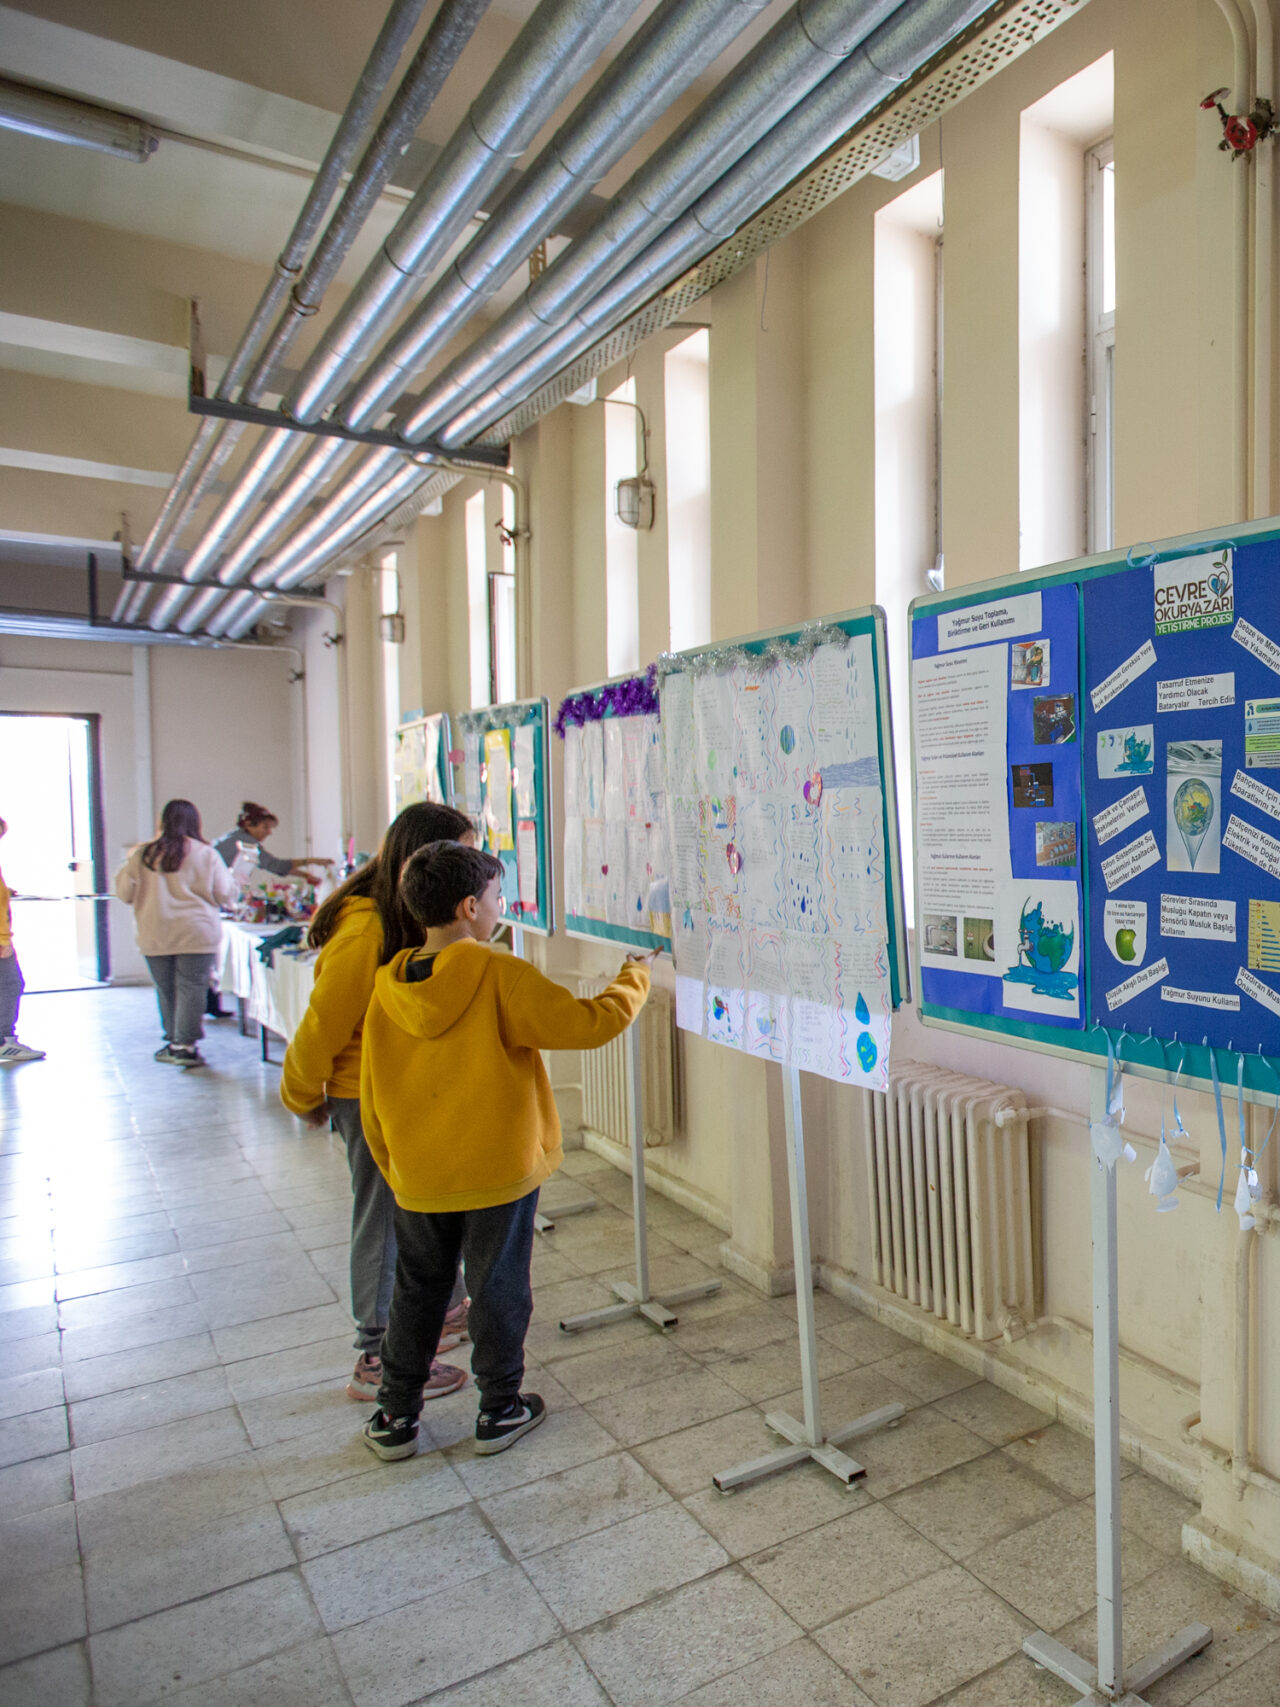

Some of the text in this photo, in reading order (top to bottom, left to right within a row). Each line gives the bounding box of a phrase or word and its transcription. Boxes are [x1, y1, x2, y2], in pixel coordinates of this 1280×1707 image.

[1155, 596, 1233, 622] OKURYAZARI
[1237, 620, 1256, 639] Sebze
[1257, 635, 1265, 645] ve
[1233, 630, 1280, 670] Suda Yıkamayın
[1158, 676, 1215, 689] Tasarruf Etmenize
[1158, 687, 1208, 700] Yardımcı Olacak
[1159, 695, 1235, 711] Bataryalar Tercih Edin
[1232, 782, 1268, 810] Aparatlarını
[1236, 771, 1265, 796] Bahçeniz
[1265, 788, 1278, 803] İçin
[1230, 816, 1260, 840] Bütçenizi
[1103, 834, 1153, 871] Sifon Sisteminde Su
[1224, 836, 1258, 863] Tüketimine
[1258, 860, 1267, 869] de
[1227, 827, 1251, 847] Elektrik
[1251, 842, 1260, 852] ve
[1260, 847, 1280, 864] Doğal
[1130, 864, 1142, 875] Alın
[1161, 905, 1229, 921] Musluğu Kapatın veya
[1189, 898, 1218, 908] Sırasında
[1161, 915, 1187, 925] Sensörlü
[1189, 919, 1212, 929] Musluk
[1161, 926, 1186, 936] Kullanın
[1237, 978, 1258, 999] Onarın
[1240, 968, 1266, 993] Sızdıran
[1162, 987, 1240, 1007] Yağmur Suyunu Kullanın
